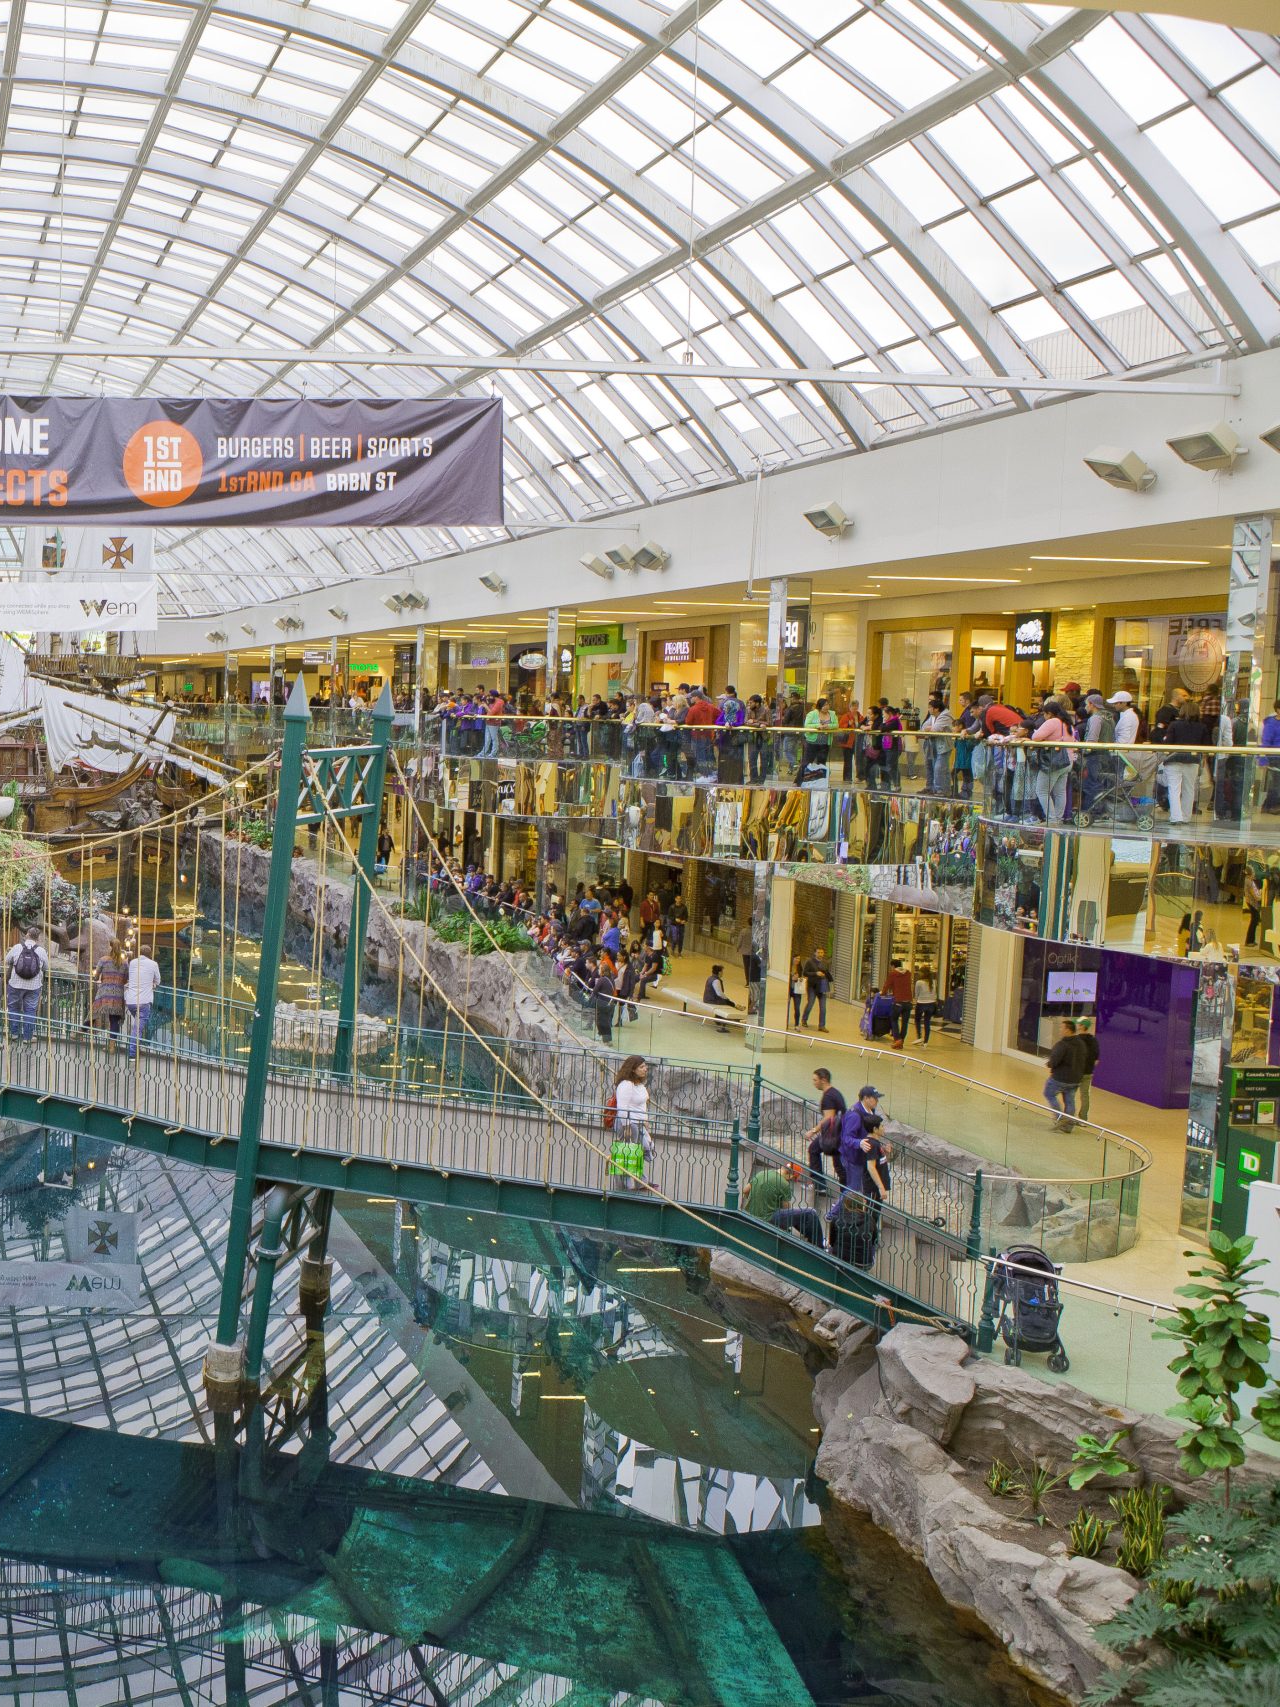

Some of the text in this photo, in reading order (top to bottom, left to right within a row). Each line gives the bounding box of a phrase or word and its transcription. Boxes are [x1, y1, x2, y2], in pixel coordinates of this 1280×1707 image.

[143, 435, 182, 460] 1ST
[217, 435, 433, 459] BURGERS BEER SPORTS
[143, 469, 182, 493] RND
[326, 471, 371, 492] BRBN
[375, 471, 397, 492] ST
[79, 599, 137, 618] Wem
[581, 633, 606, 645] crocs
[664, 641, 690, 655] PEOPLES
[1015, 643, 1041, 655] Roots
[1240, 1151, 1259, 1172] TD
